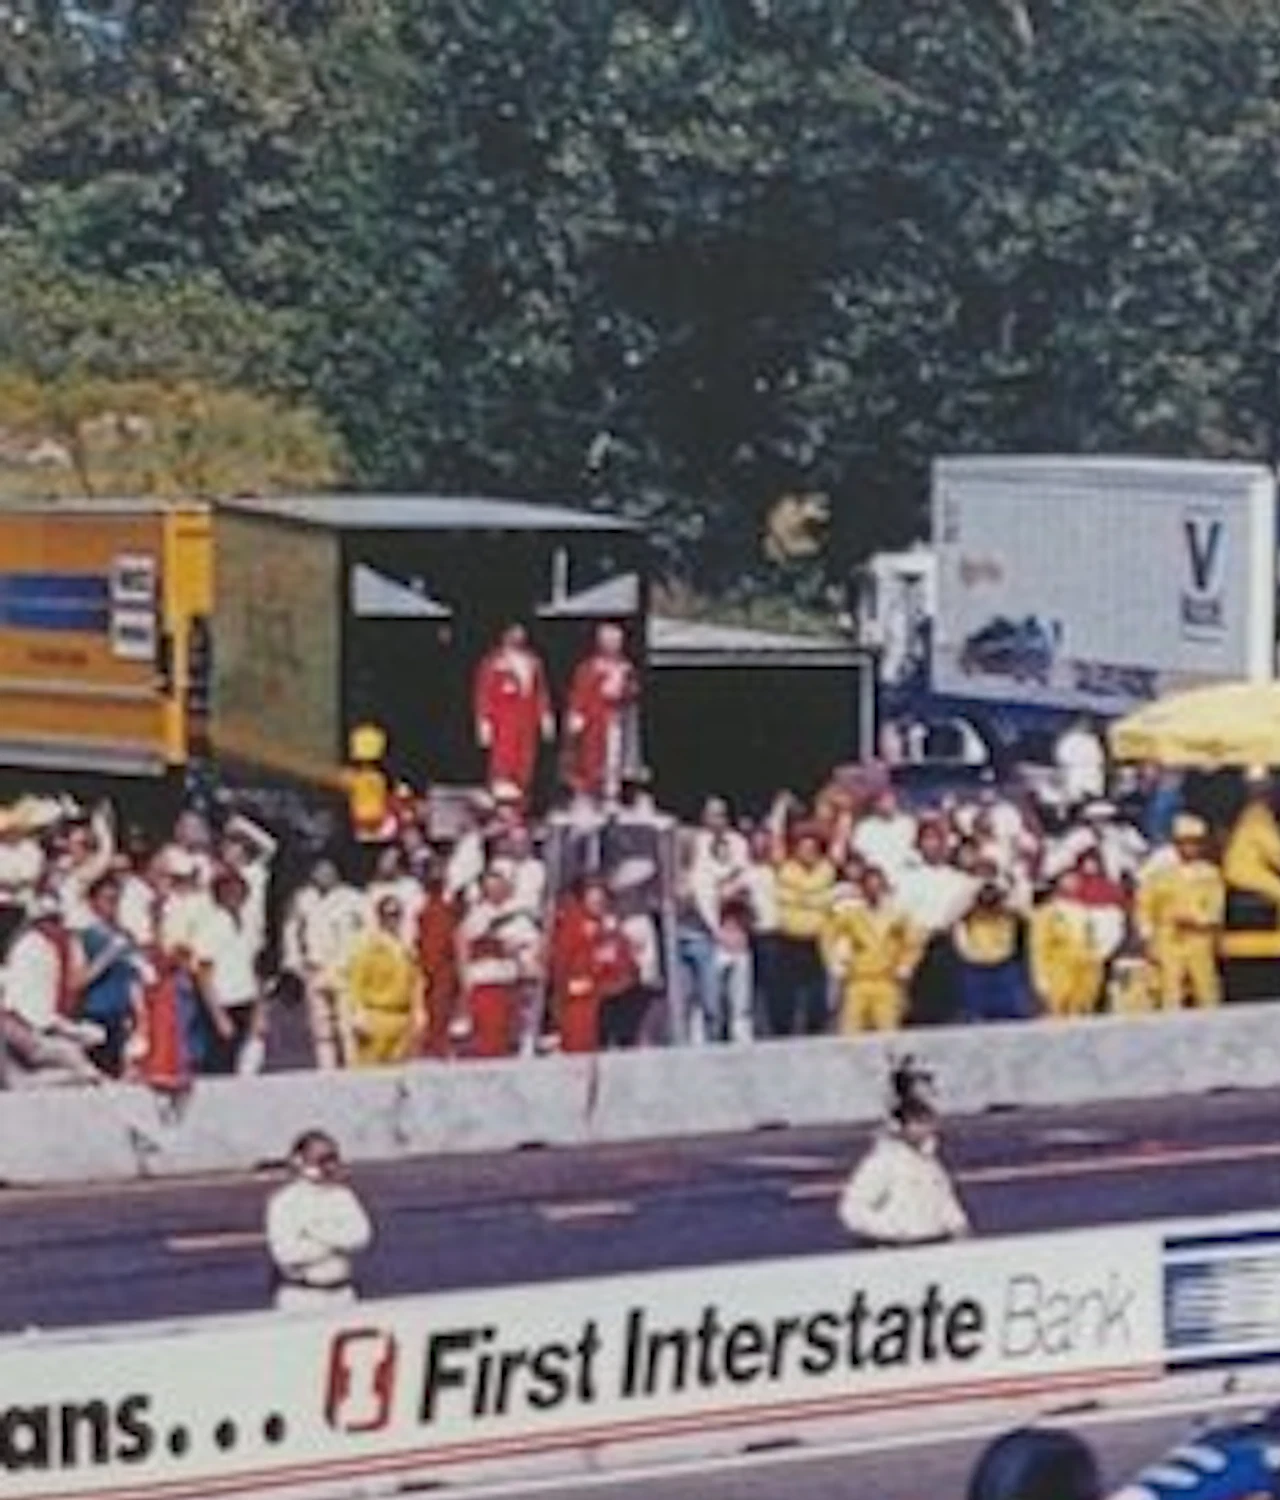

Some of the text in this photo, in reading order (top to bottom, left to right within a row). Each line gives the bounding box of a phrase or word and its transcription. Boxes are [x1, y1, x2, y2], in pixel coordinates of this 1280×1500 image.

[419, 1272, 1137, 1425] First Interstate Bank
